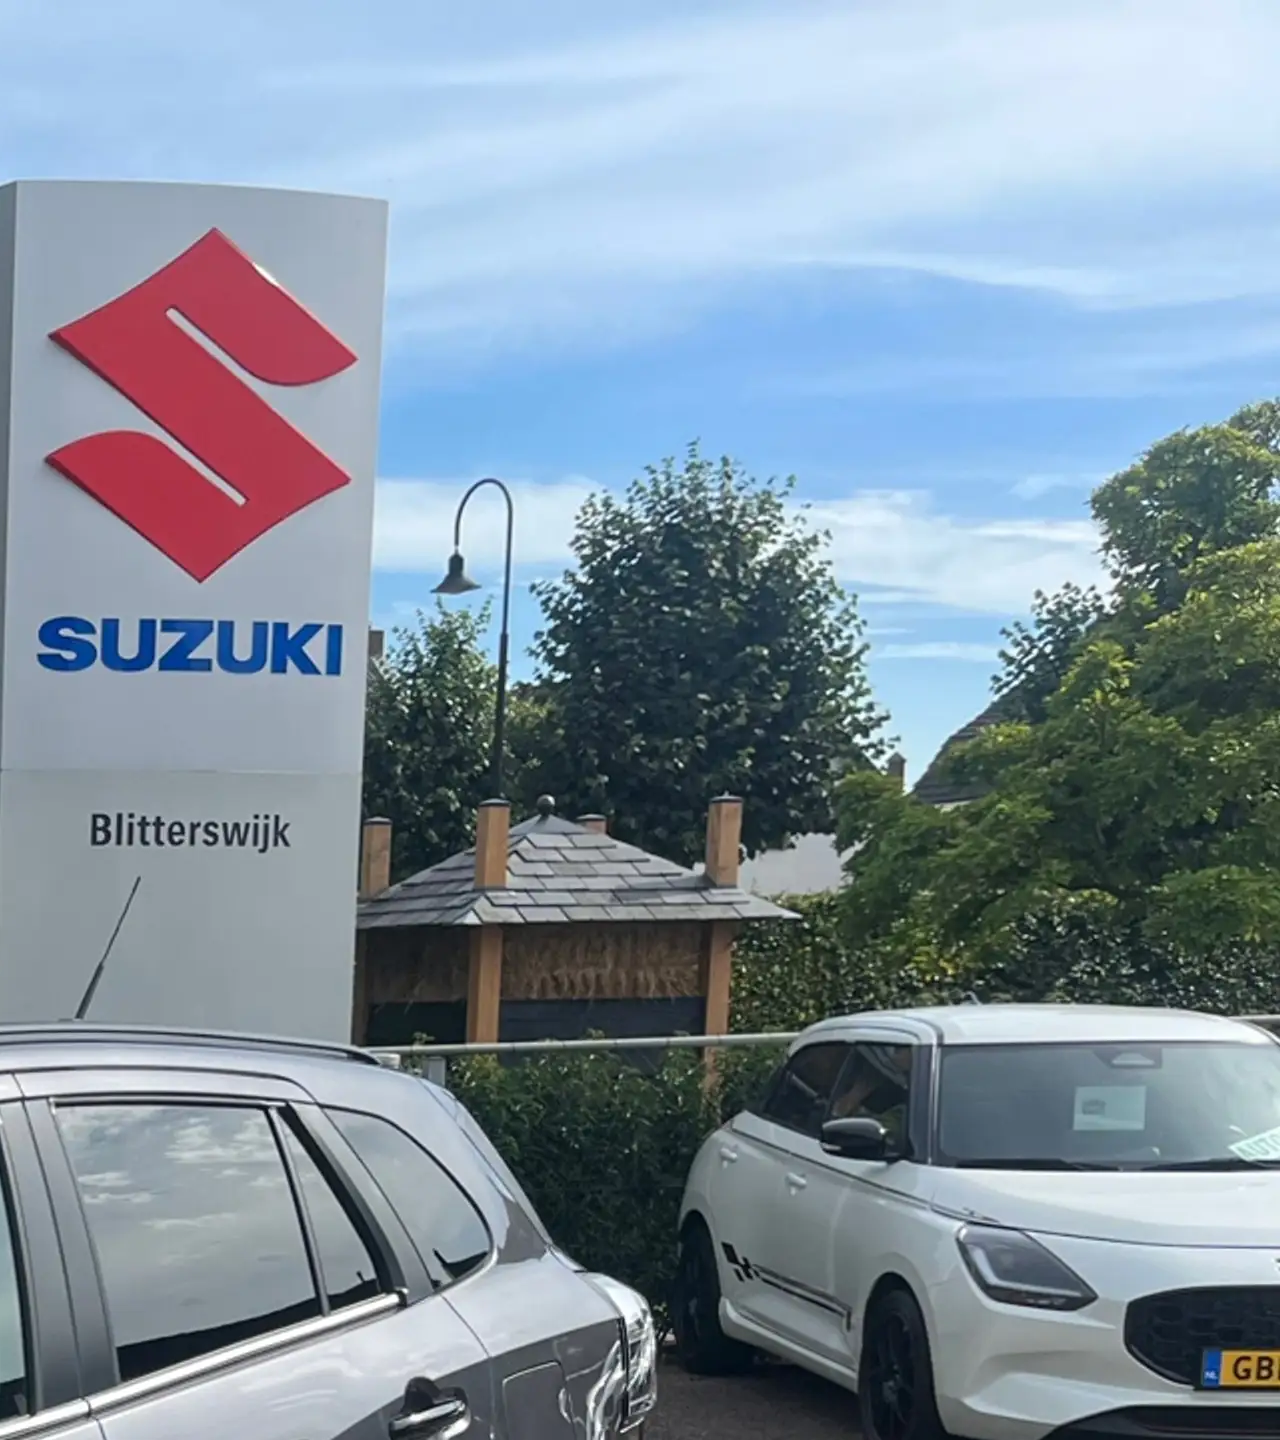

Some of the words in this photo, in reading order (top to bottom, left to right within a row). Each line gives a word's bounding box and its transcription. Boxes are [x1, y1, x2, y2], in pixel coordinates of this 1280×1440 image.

[36, 615, 344, 677] SUZUKI
[90, 812, 291, 854] Blitterswijk
[1233, 1355, 1280, 1381] GB
